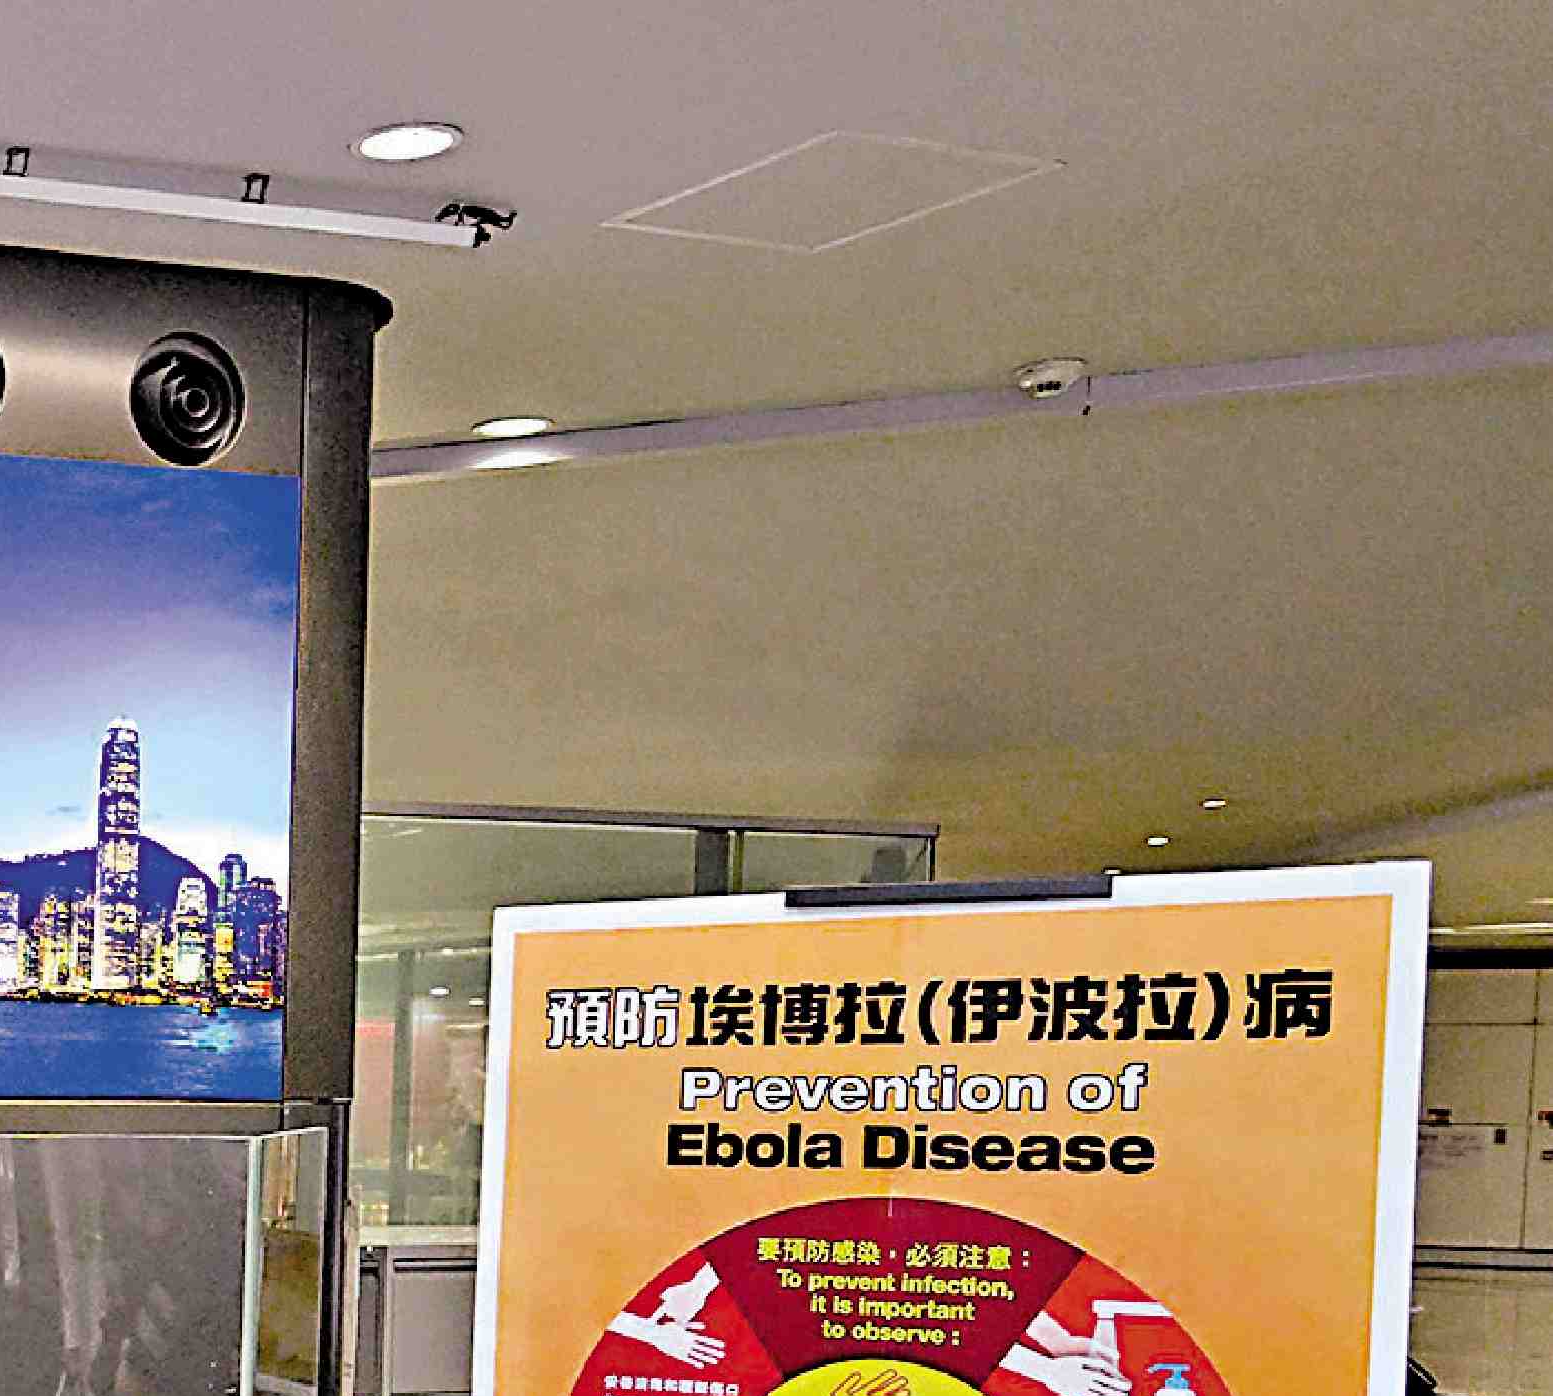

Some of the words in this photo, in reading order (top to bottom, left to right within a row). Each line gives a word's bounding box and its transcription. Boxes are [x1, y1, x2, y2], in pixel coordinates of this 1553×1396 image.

[680, 1066, 1046, 1113] Prevention
[1066, 1062, 1148, 1113] of
[666, 1122, 842, 1172] Ebola
[863, 1124, 1155, 1174] Disease
[777, 1268, 802, 1288] To
[808, 1273, 896, 1293] prevent
[901, 1273, 1015, 1300] infection,
[810, 1294, 826, 1313] it
[833, 1296, 853, 1314] is
[858, 1296, 976, 1321] important
[822, 1320, 845, 1338] to
[852, 1321, 946, 1344] observe
